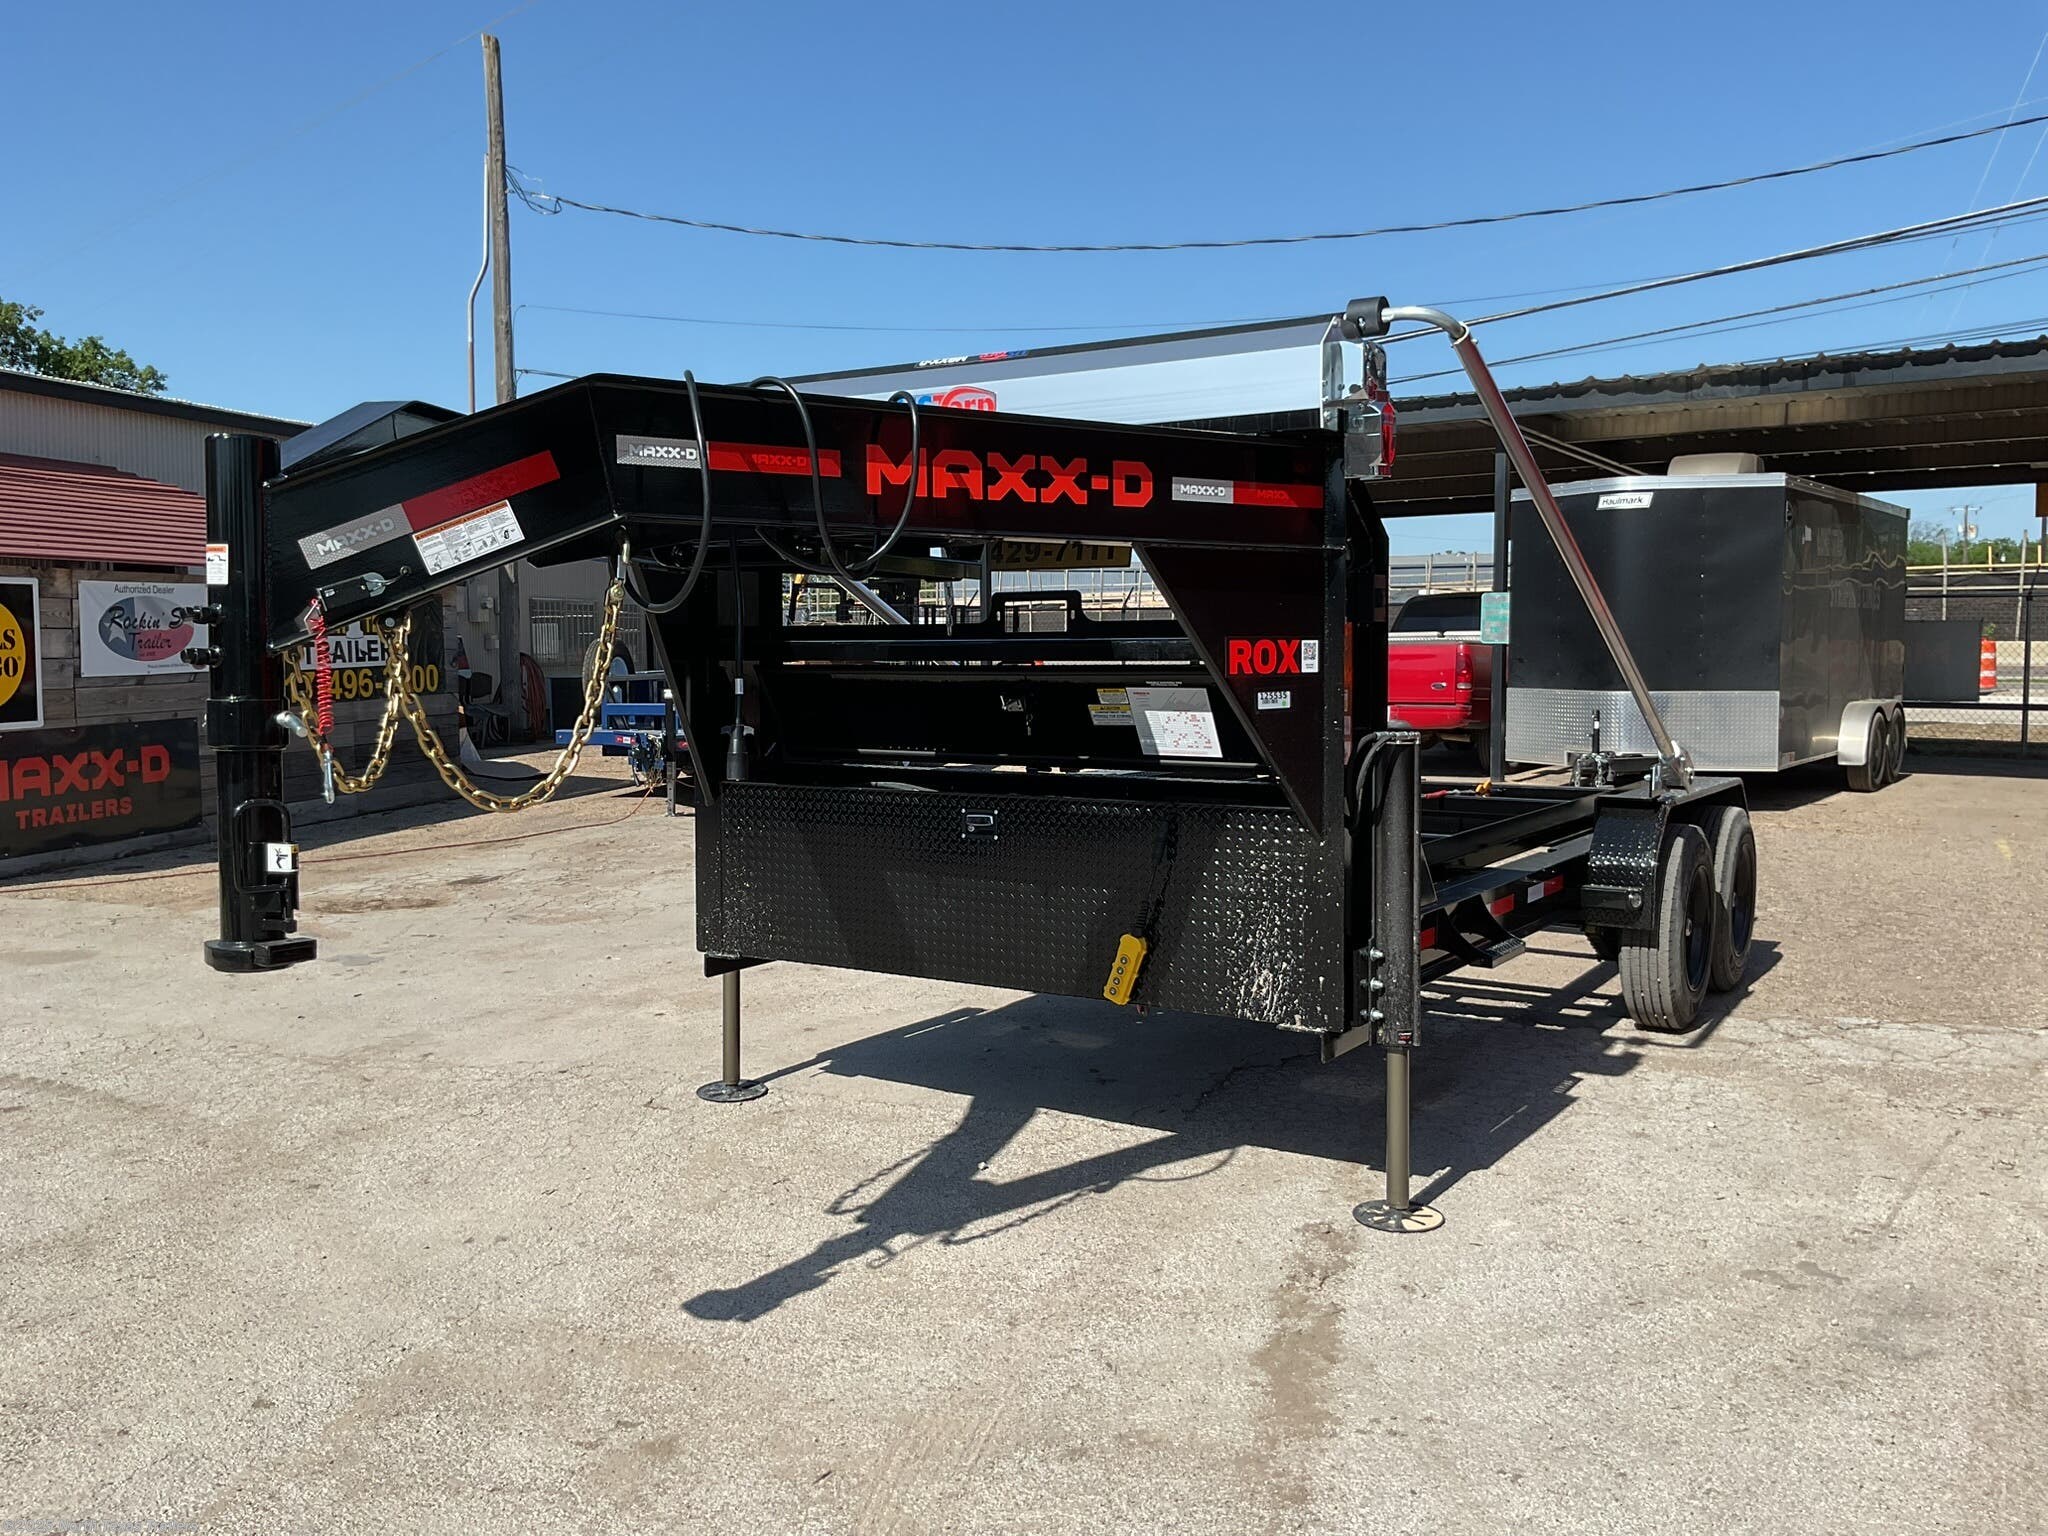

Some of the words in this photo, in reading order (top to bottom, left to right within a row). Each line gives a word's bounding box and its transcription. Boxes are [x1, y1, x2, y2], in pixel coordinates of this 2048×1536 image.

[628, 443, 698, 460] MAXX-D
[866, 444, 1154, 508] MAXX-D
[1180, 484, 1226, 497] MAXX-D
[1601, 495, 1643, 506] Haulmark
[315, 517, 396, 556] MAXX-D
[114, 584, 151, 594] Authorized
[152, 585, 175, 595] Dealer
[107, 605, 165, 630] Rockin'
[128, 631, 173, 651] Trailer
[1229, 639, 1301, 675] ROX
[15, 797, 133, 830] TRAILERS
